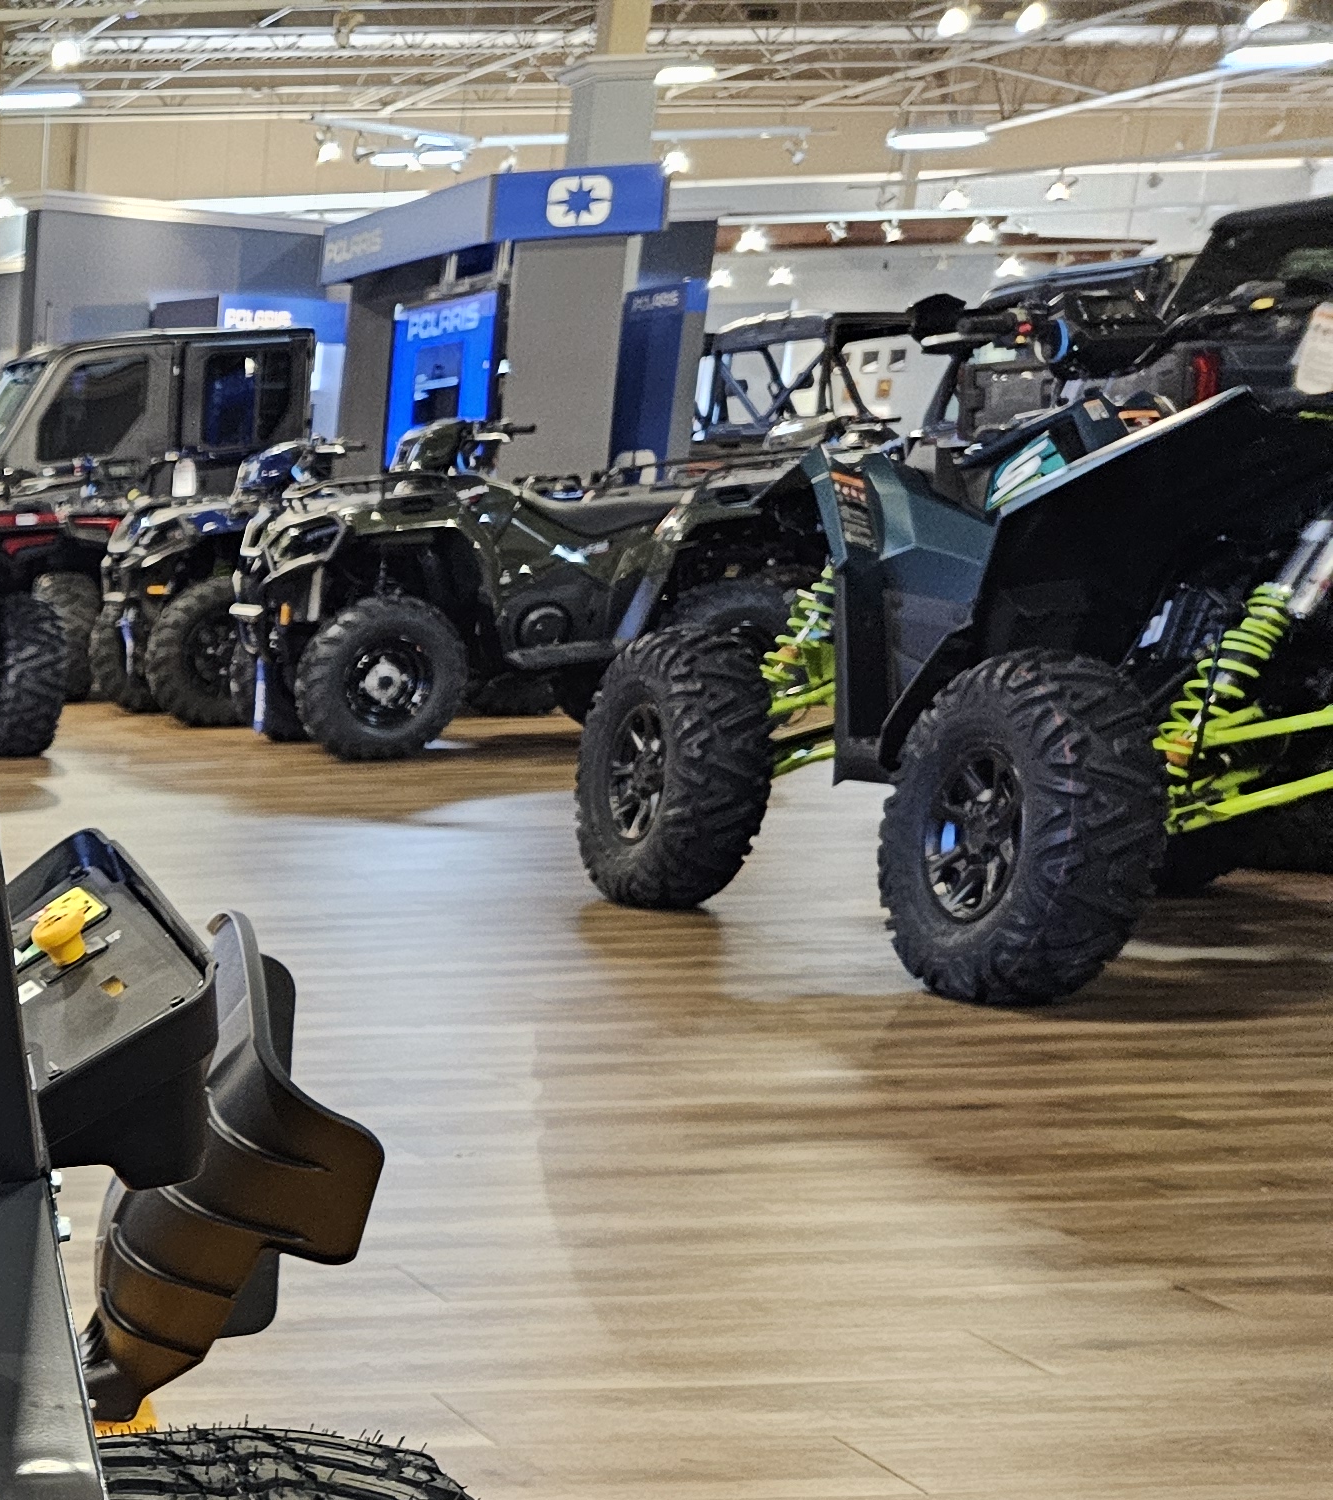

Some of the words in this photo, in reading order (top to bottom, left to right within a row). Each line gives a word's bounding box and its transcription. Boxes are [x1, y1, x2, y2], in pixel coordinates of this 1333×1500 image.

[325, 228, 382, 264] POLARIS
[224, 308, 292, 329] POLARIS
[407, 302, 480, 341] POLARIS
